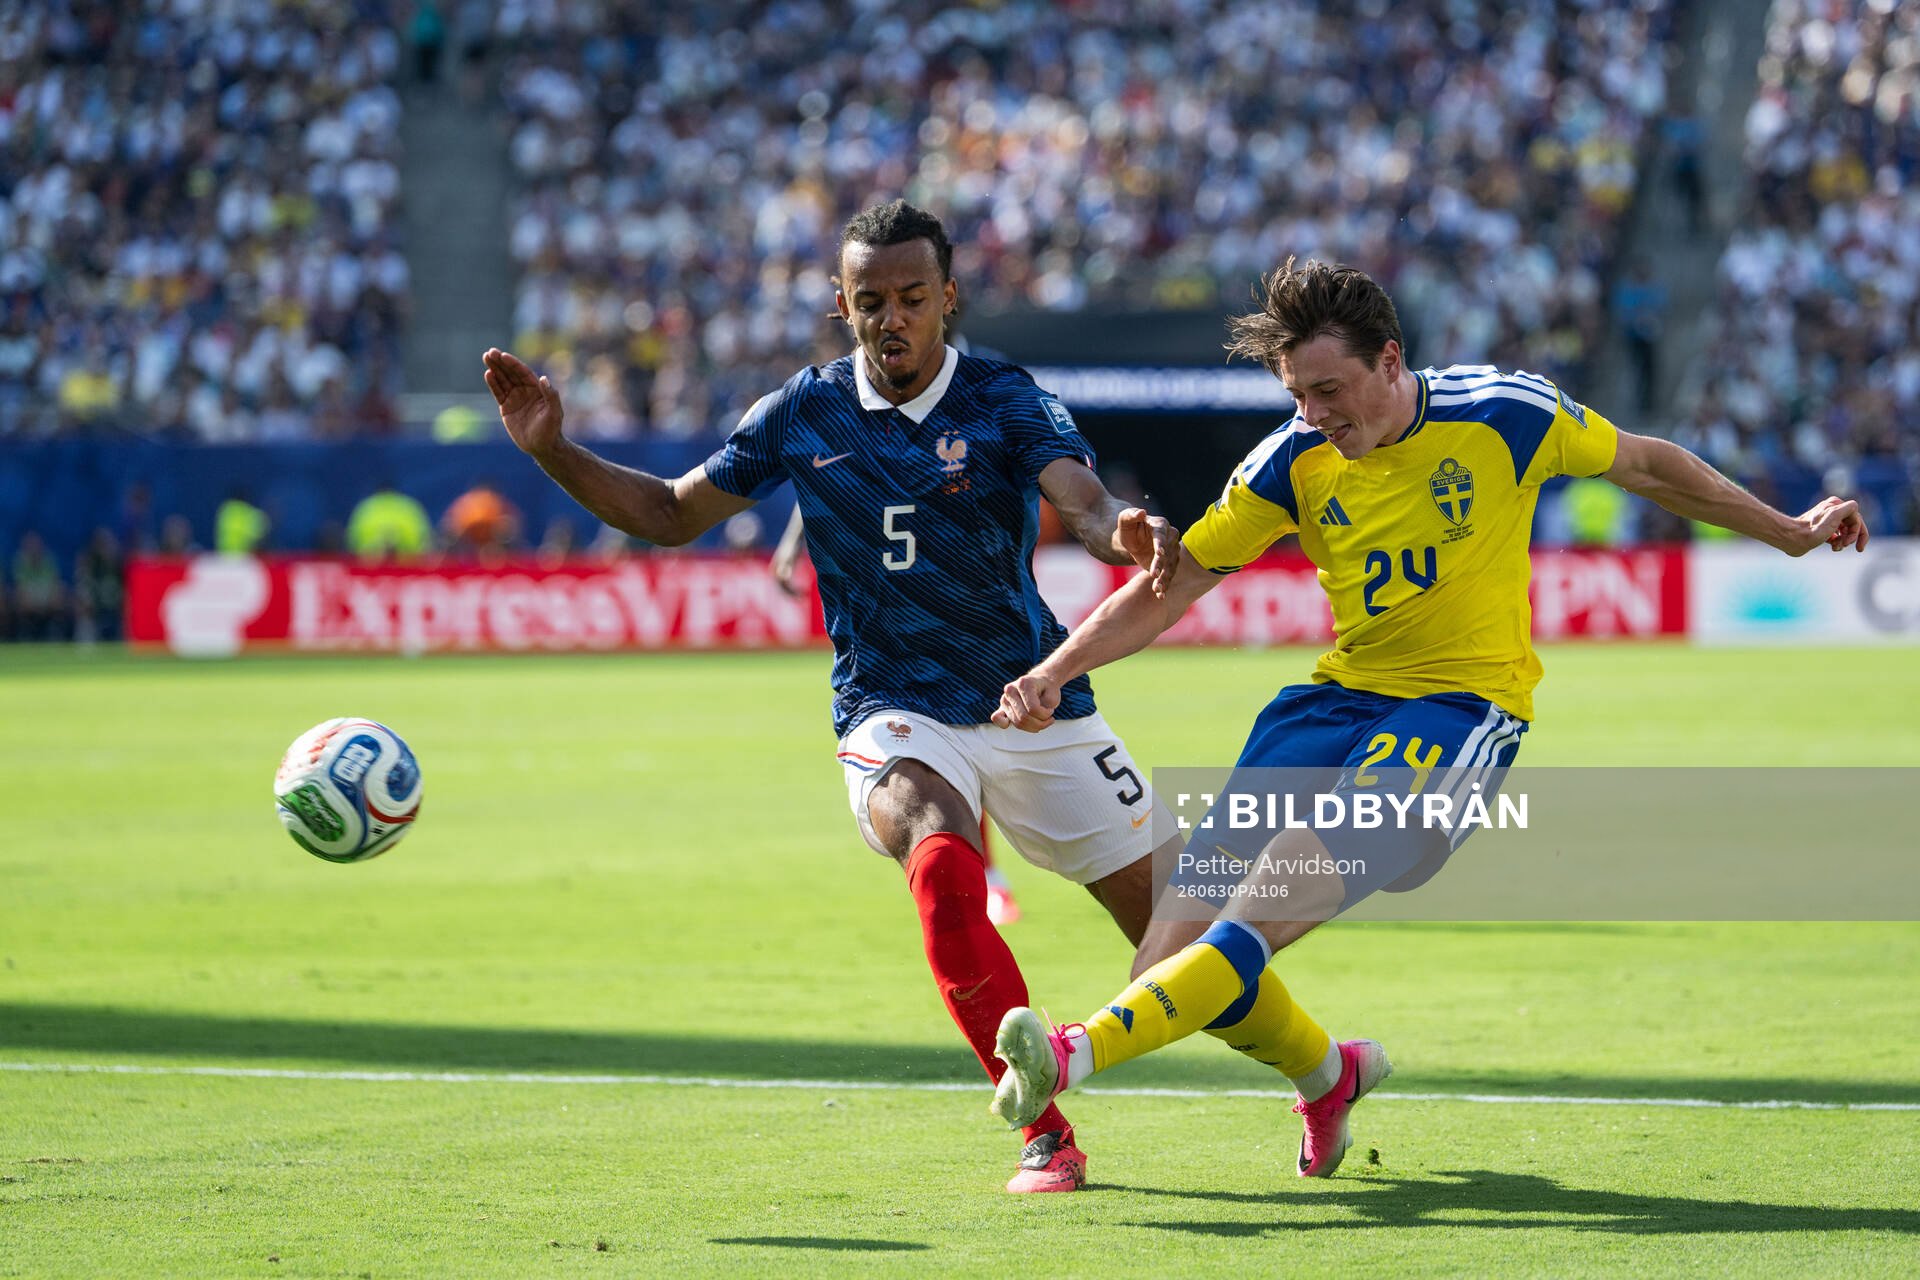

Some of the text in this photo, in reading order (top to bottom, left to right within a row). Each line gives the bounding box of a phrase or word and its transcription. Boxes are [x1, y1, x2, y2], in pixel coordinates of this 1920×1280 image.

[1436, 475, 1466, 486] SVERIGE
[883, 505, 916, 571] 5
[291, 561, 808, 651] ExpressVPN
[1363, 546, 1437, 616] 24
[1093, 744, 1143, 806] 5
[1354, 733, 1443, 794] 24
